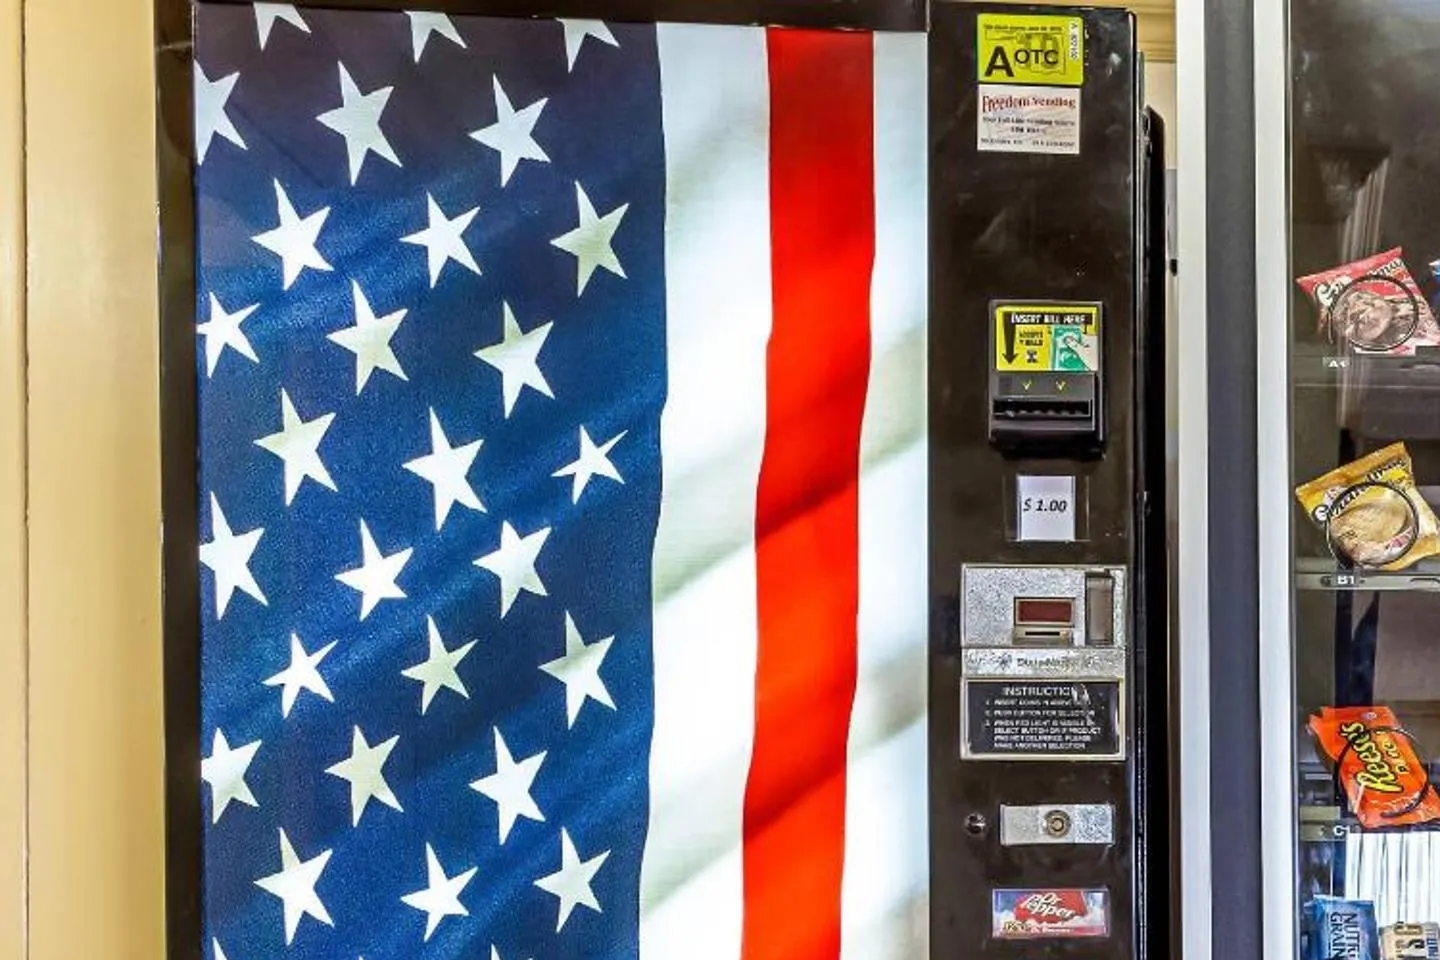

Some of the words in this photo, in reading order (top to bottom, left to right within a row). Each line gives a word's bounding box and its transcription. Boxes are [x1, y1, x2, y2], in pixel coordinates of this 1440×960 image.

[982, 95, 1030, 113] Freedom
[1032, 96, 1076, 109] Vending
[1011, 313, 1042, 324] INSERT
[1044, 313, 1061, 324] BILL
[1063, 314, 1085, 324] HERE
[1023, 498, 1031, 512] $
[1036, 499, 1068, 512] 1.00
[1337, 575, 1355, 584] B1
[1019, 894, 1077, 918] Pepper
